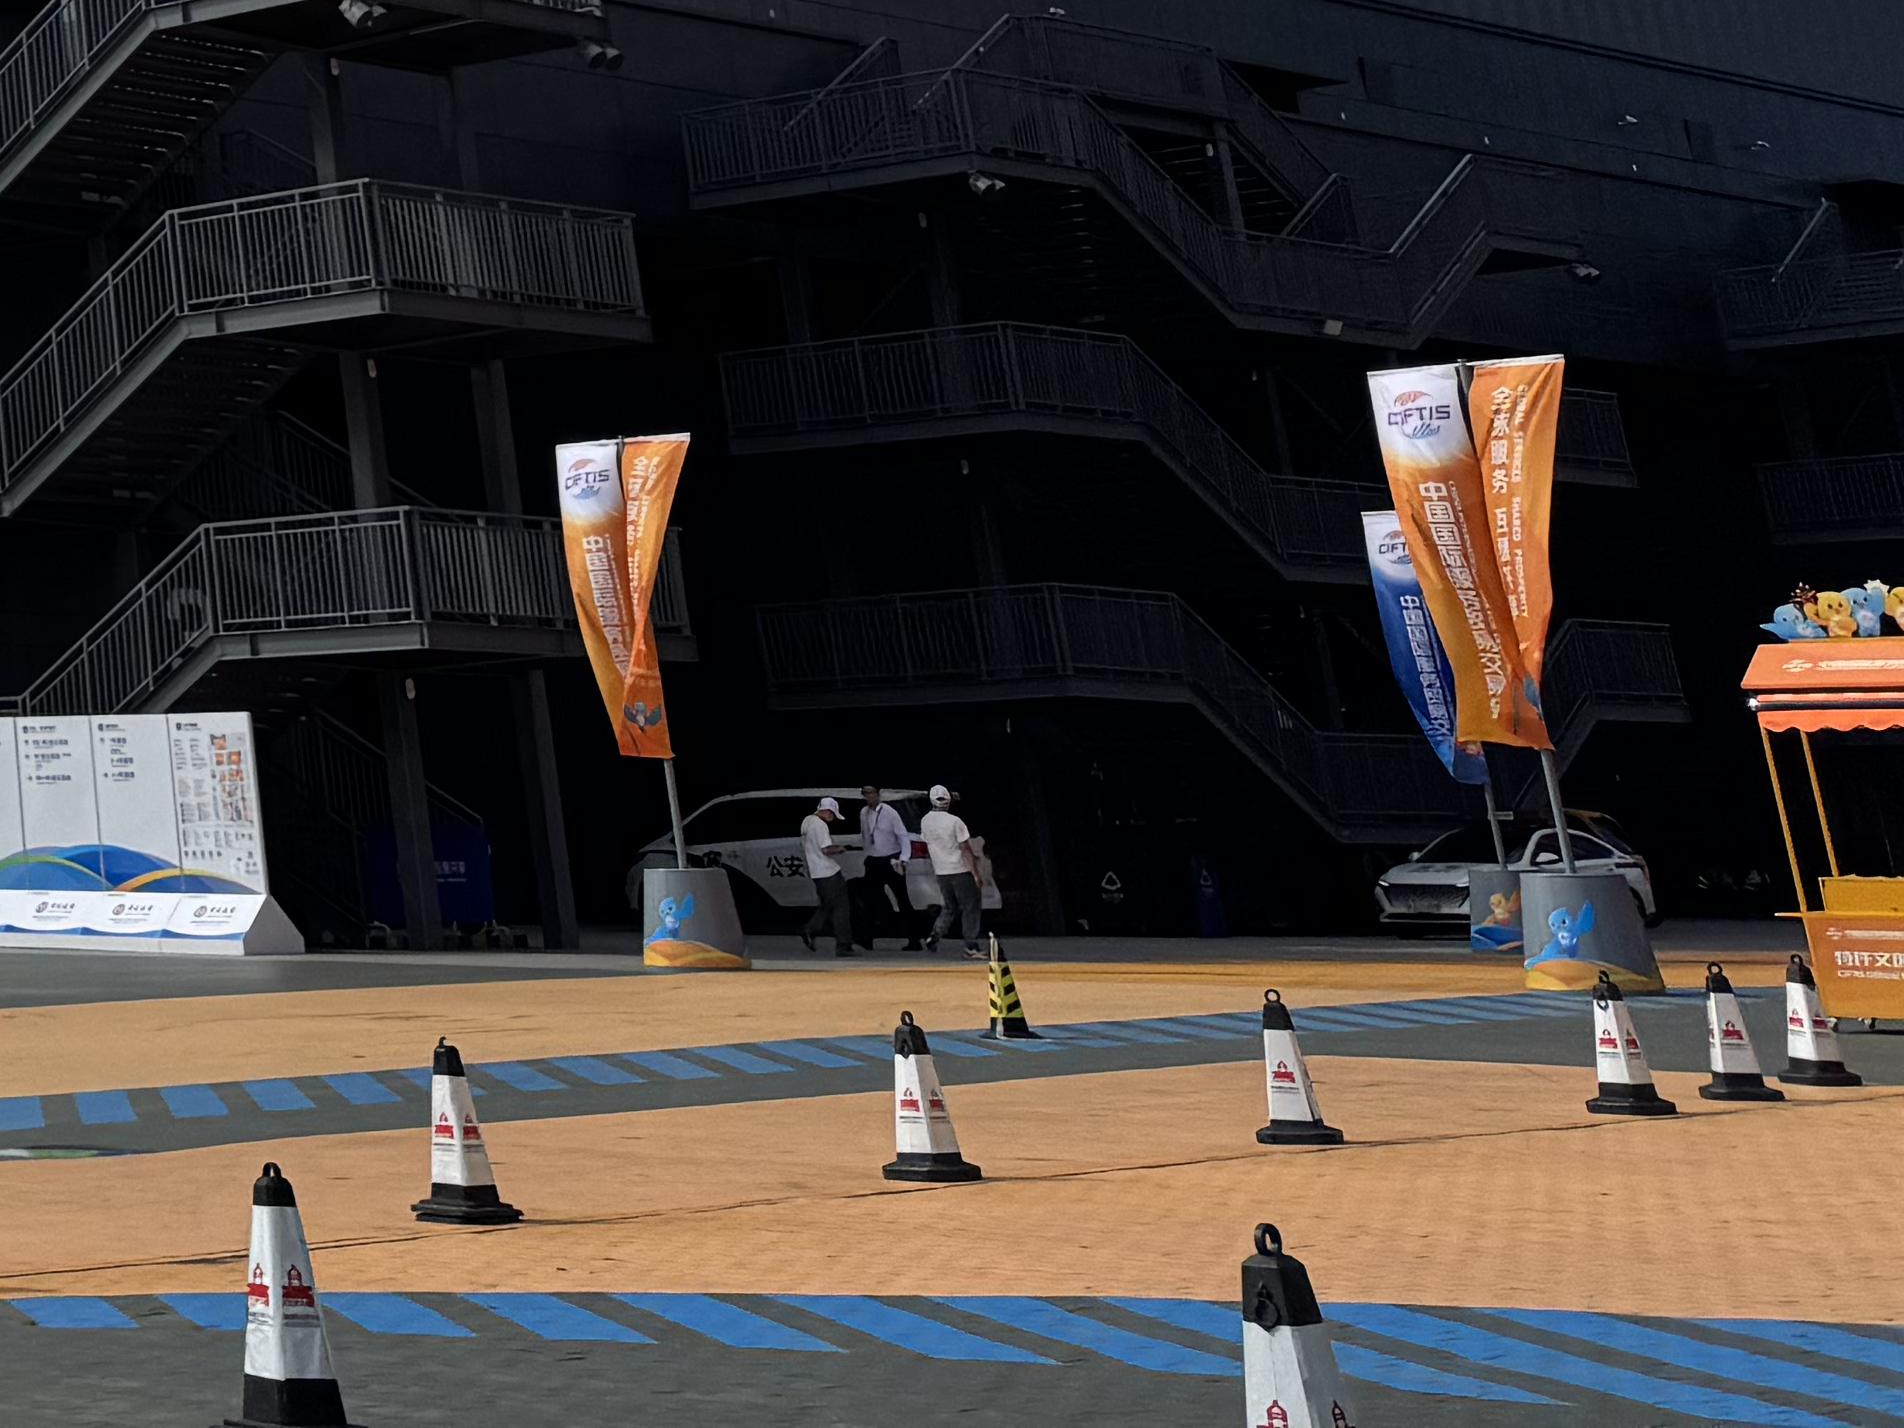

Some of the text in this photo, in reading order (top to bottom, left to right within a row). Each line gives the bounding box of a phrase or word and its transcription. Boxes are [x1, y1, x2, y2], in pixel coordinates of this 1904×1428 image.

[1388, 405, 1450, 426] CIFTIS
[1379, 543, 1408, 555] CIFT
[767, 856, 805, 877] 公安
